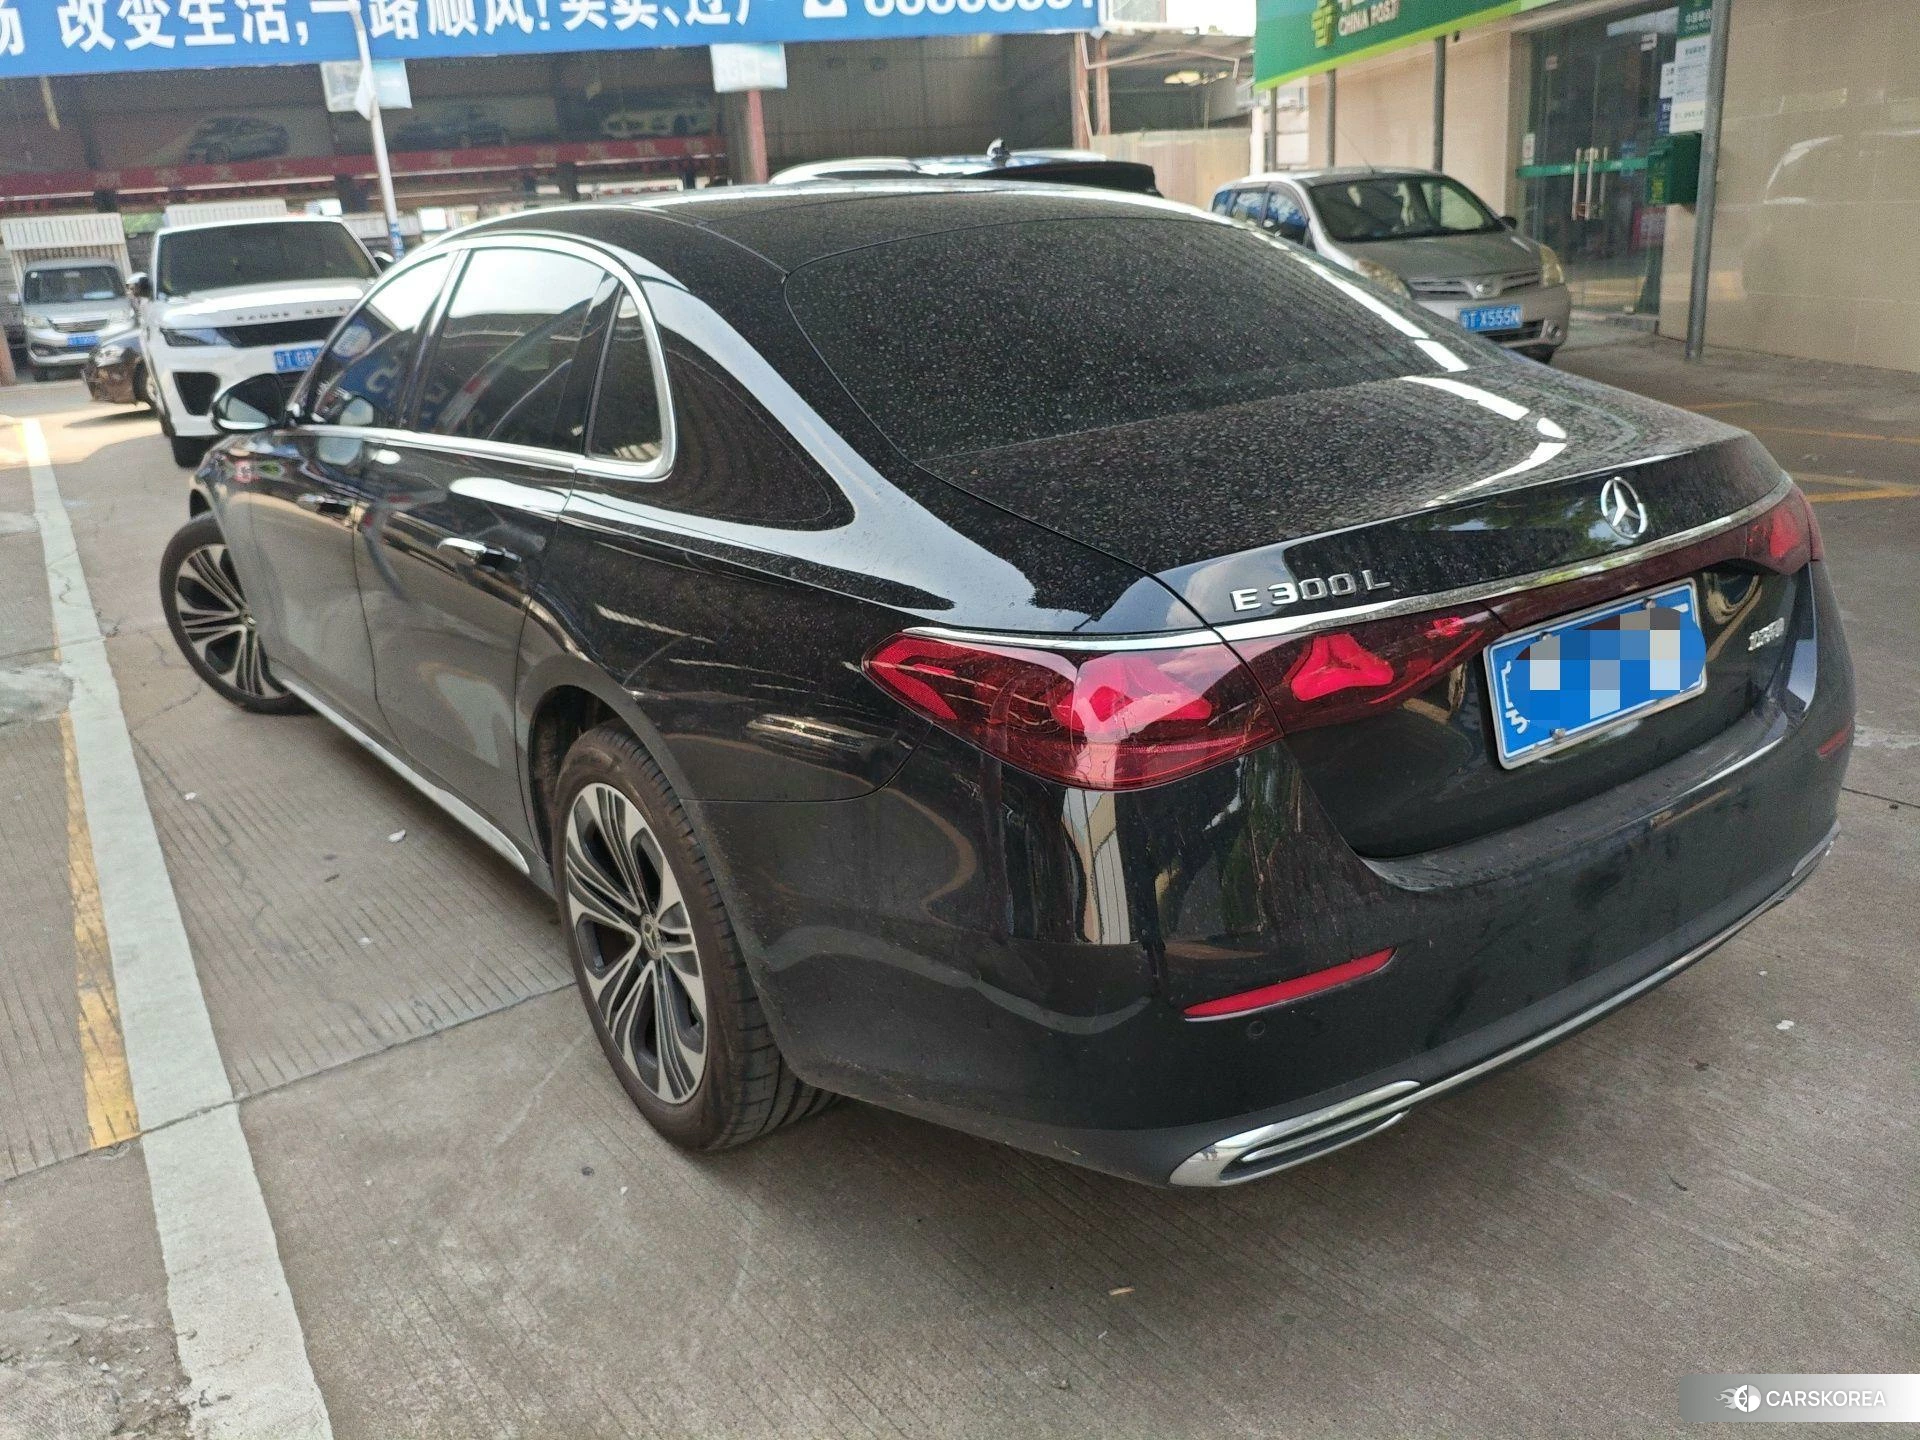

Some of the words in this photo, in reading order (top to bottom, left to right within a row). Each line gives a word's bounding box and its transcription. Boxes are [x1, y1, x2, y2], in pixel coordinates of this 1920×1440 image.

[1338, 9, 1369, 37] CHINA
[1230, 588, 1262, 612] E
[1267, 573, 1357, 606] 300
[1361, 569, 1391, 591] L
